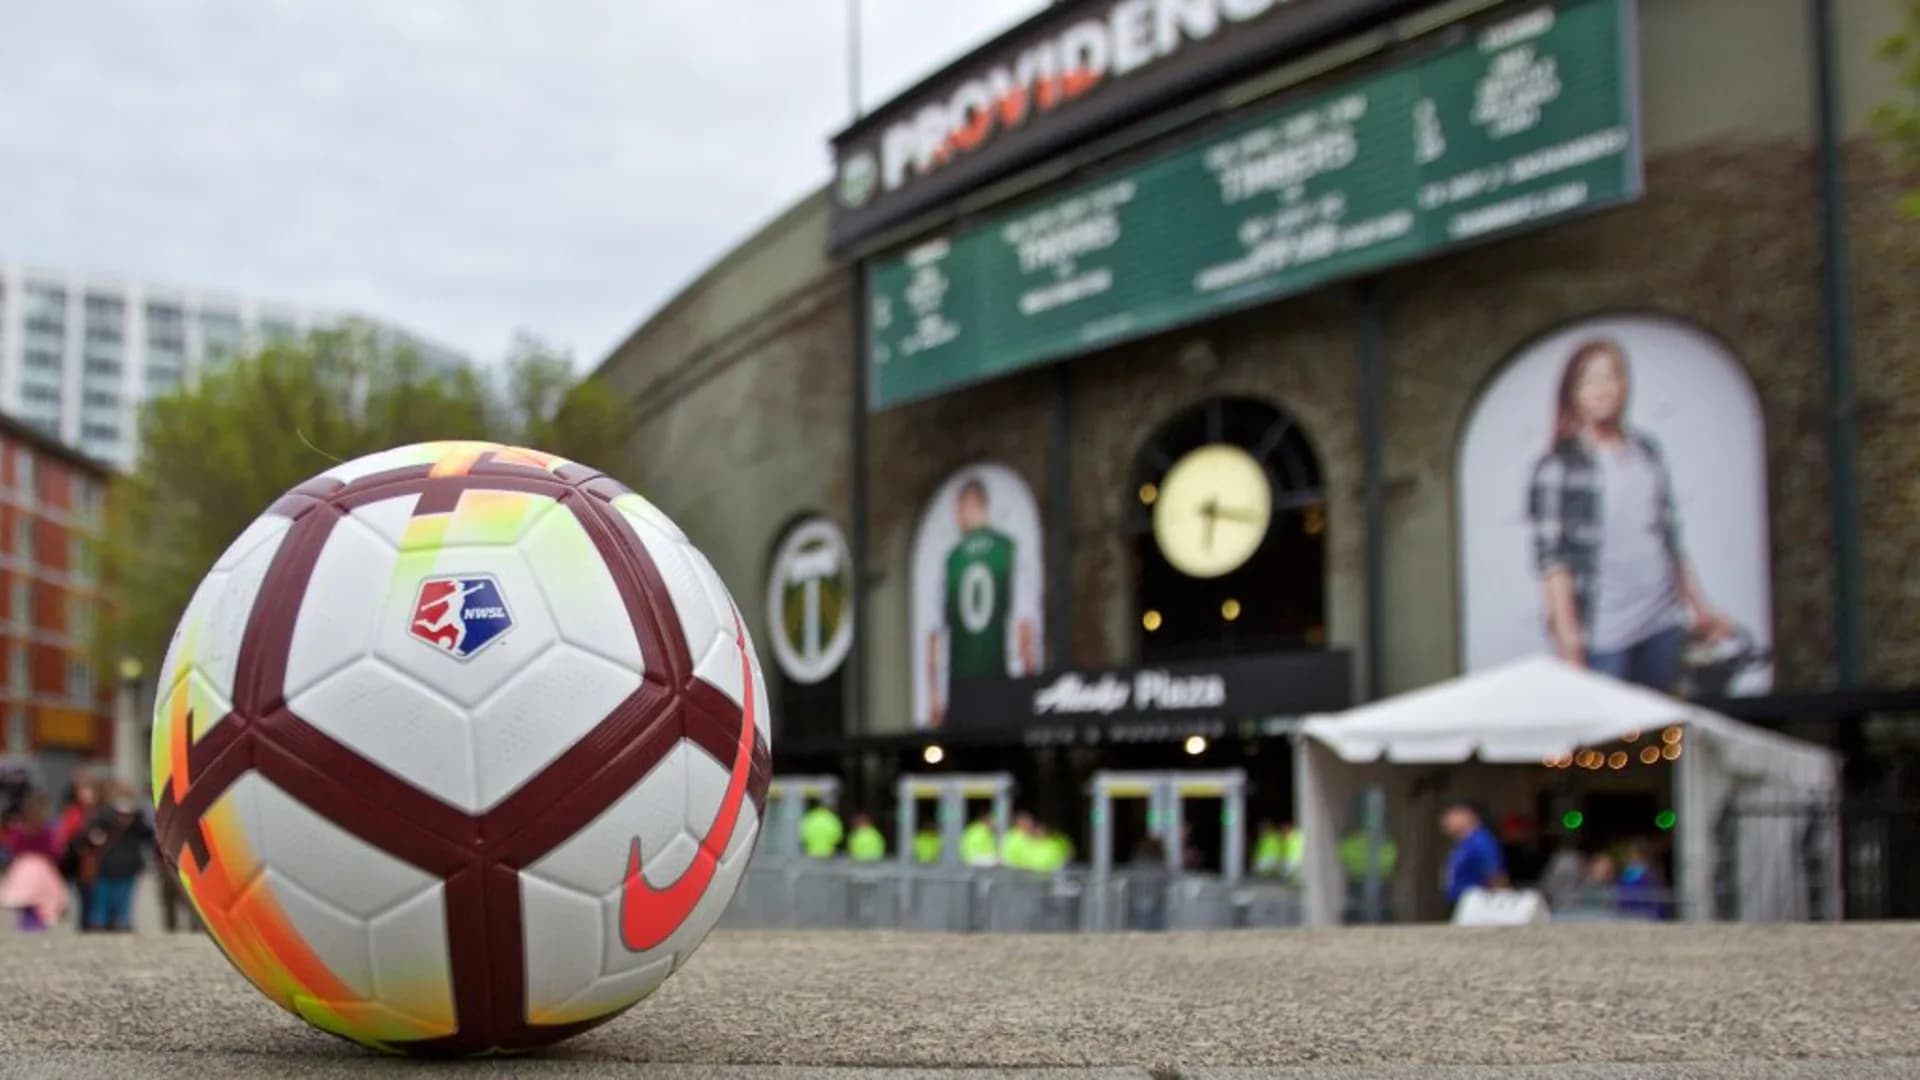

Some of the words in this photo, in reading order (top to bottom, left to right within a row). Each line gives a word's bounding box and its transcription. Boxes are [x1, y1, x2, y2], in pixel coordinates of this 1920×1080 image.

[881, 0, 1282, 190] PROVIDEN
[463, 606, 505, 620] NWSL
[1133, 669, 1226, 709] Plaza
